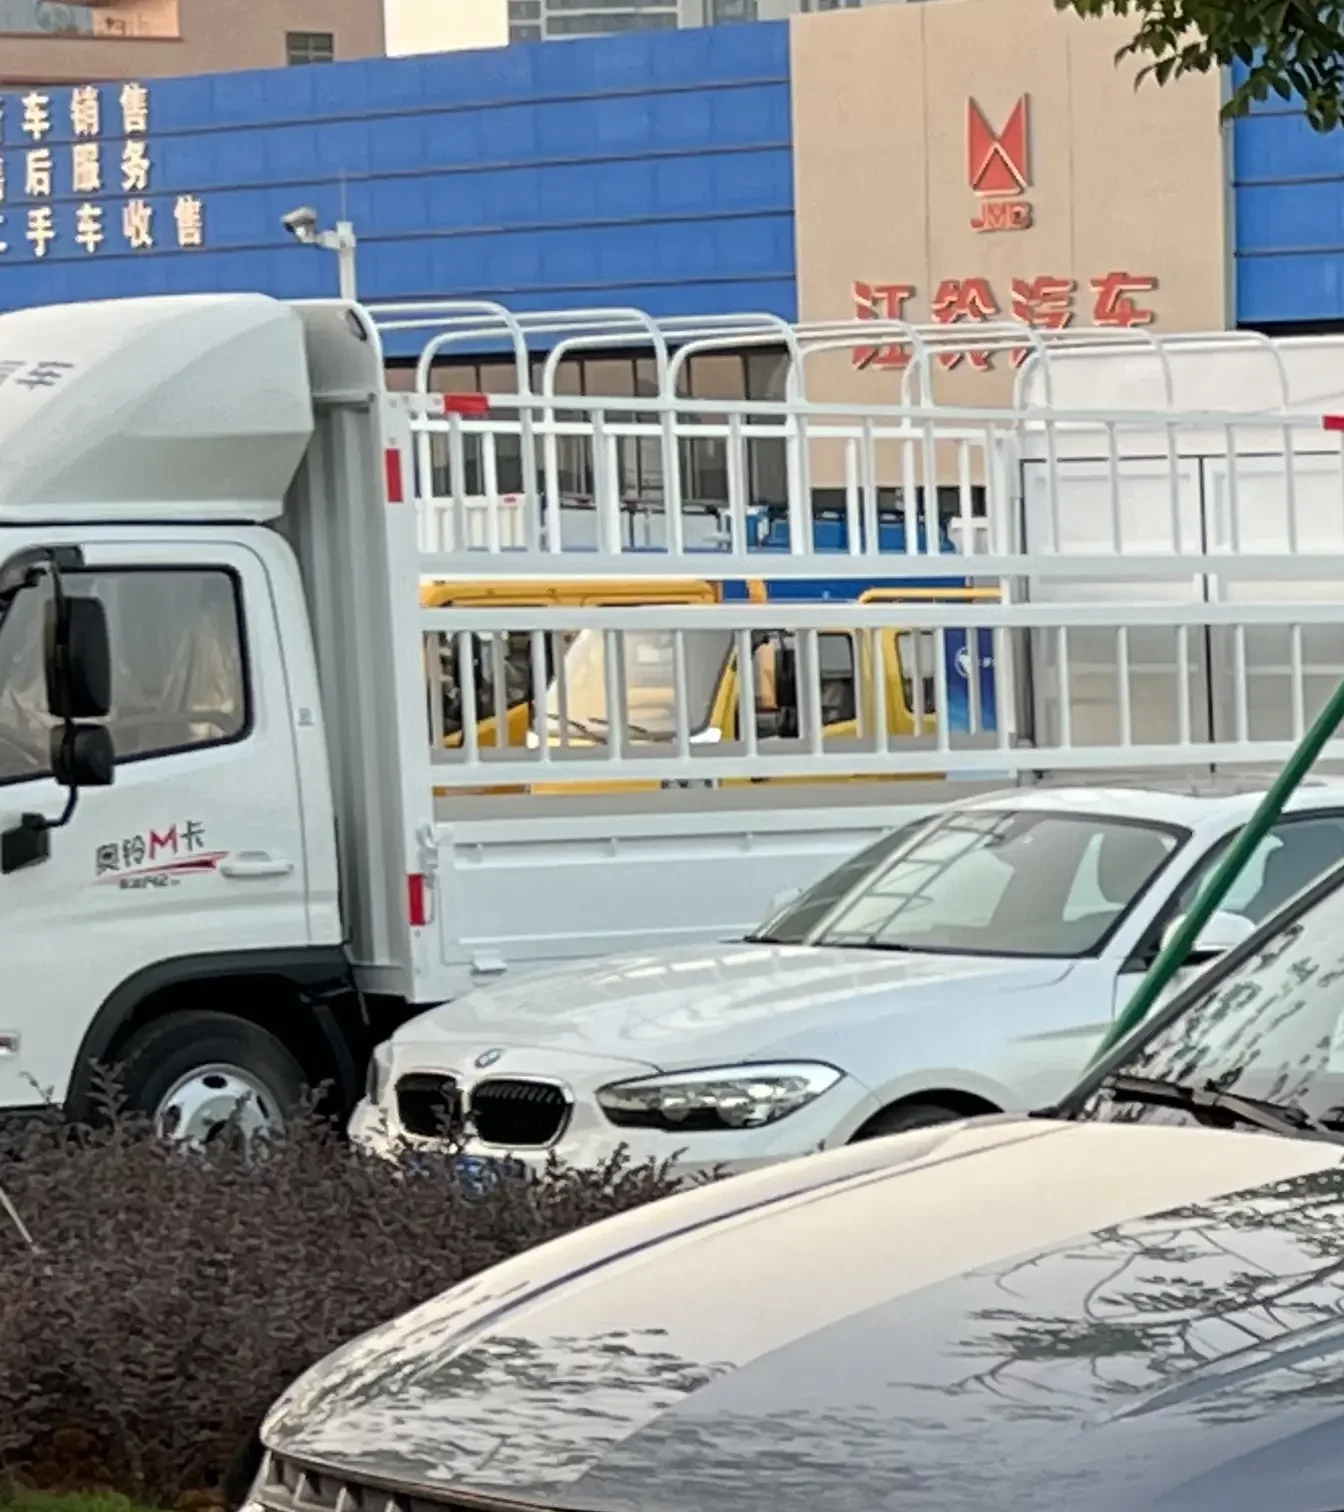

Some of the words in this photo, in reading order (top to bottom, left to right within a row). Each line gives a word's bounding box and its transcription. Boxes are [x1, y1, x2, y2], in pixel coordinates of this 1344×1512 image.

[0, 82, 148, 140] 车销售
[0, 140, 150, 200] 后服务
[0, 195, 203, 256] 手车收售
[970, 202, 1031, 231] JMC
